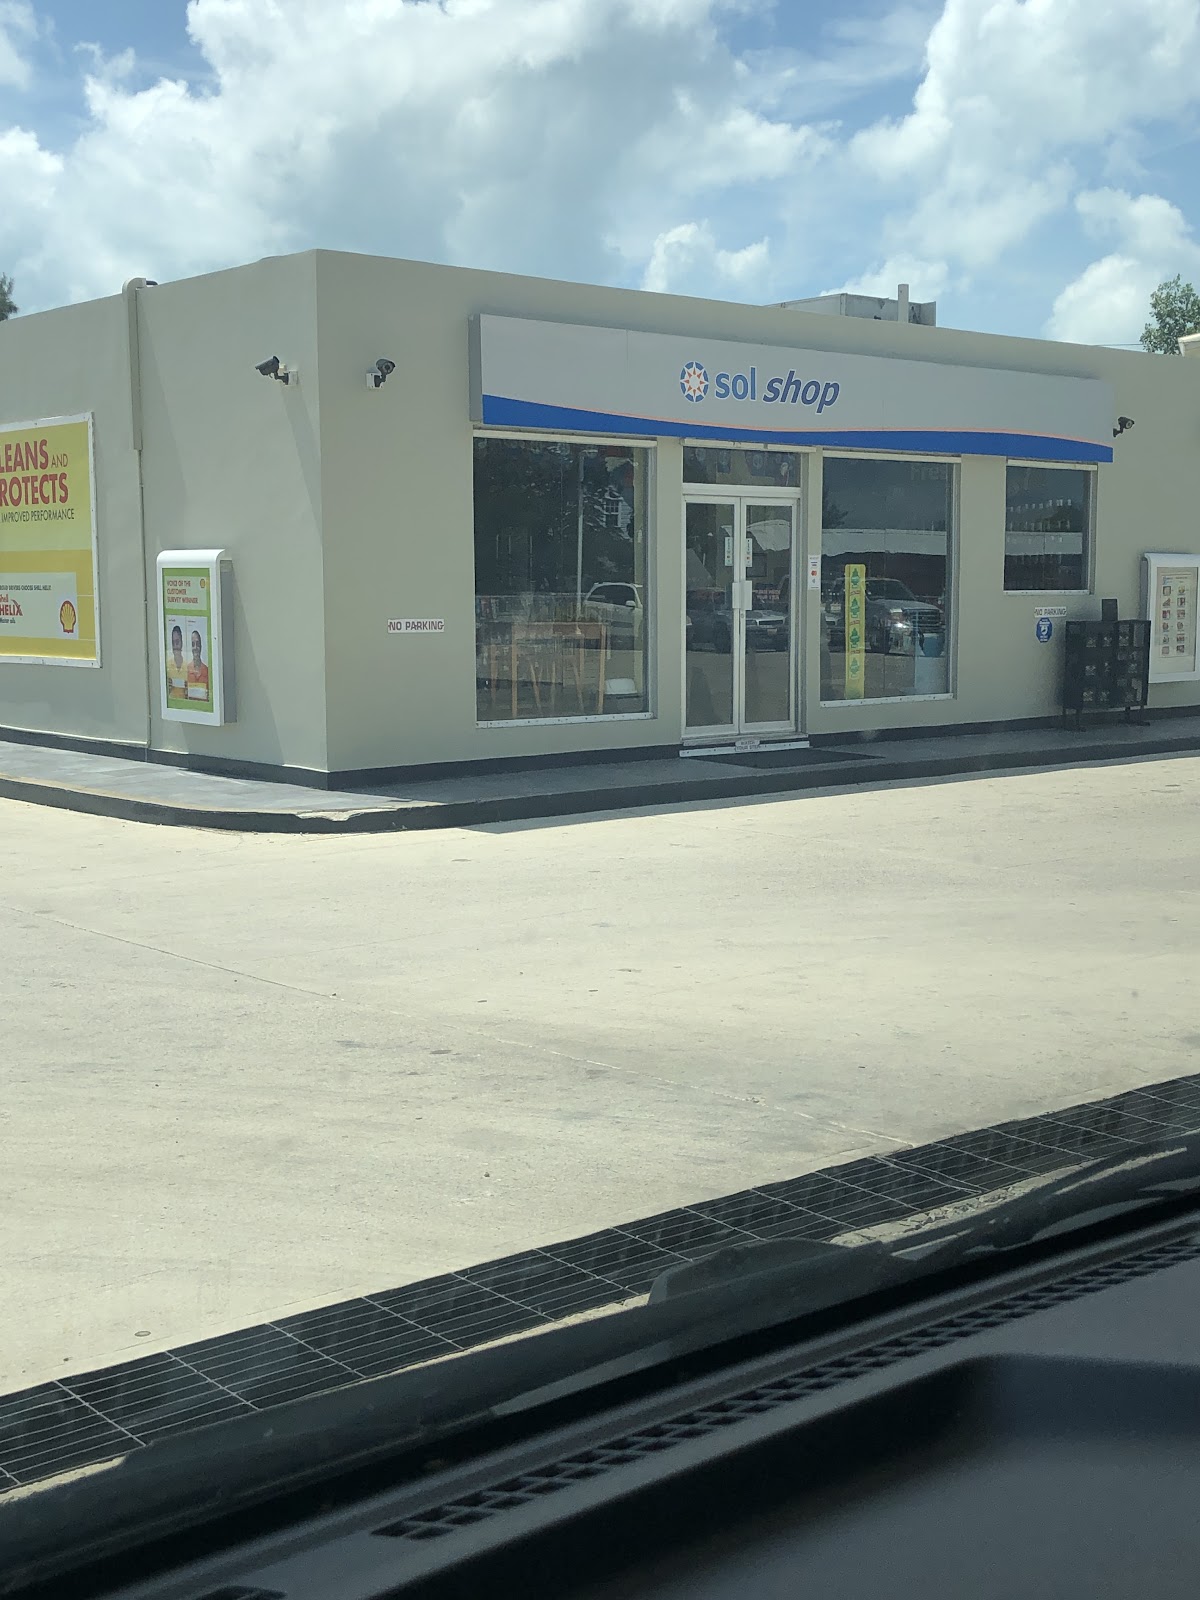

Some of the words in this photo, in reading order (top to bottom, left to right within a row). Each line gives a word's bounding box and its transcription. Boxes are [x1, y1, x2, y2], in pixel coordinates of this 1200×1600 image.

[715, 366, 756, 401] sol
[763, 370, 840, 414] shop
[51, 453, 69, 468] AND
[0, 472, 69, 507] ROTECTS
[1, 512, 30, 523] IMPROVED
[31, 508, 75, 521] PERFORMANCE
[0, 599, 23, 616] HELIX
[1044, 608, 1066, 616] PARKING
[389, 621, 402, 631] NO
[405, 621, 443, 631] PARKING
